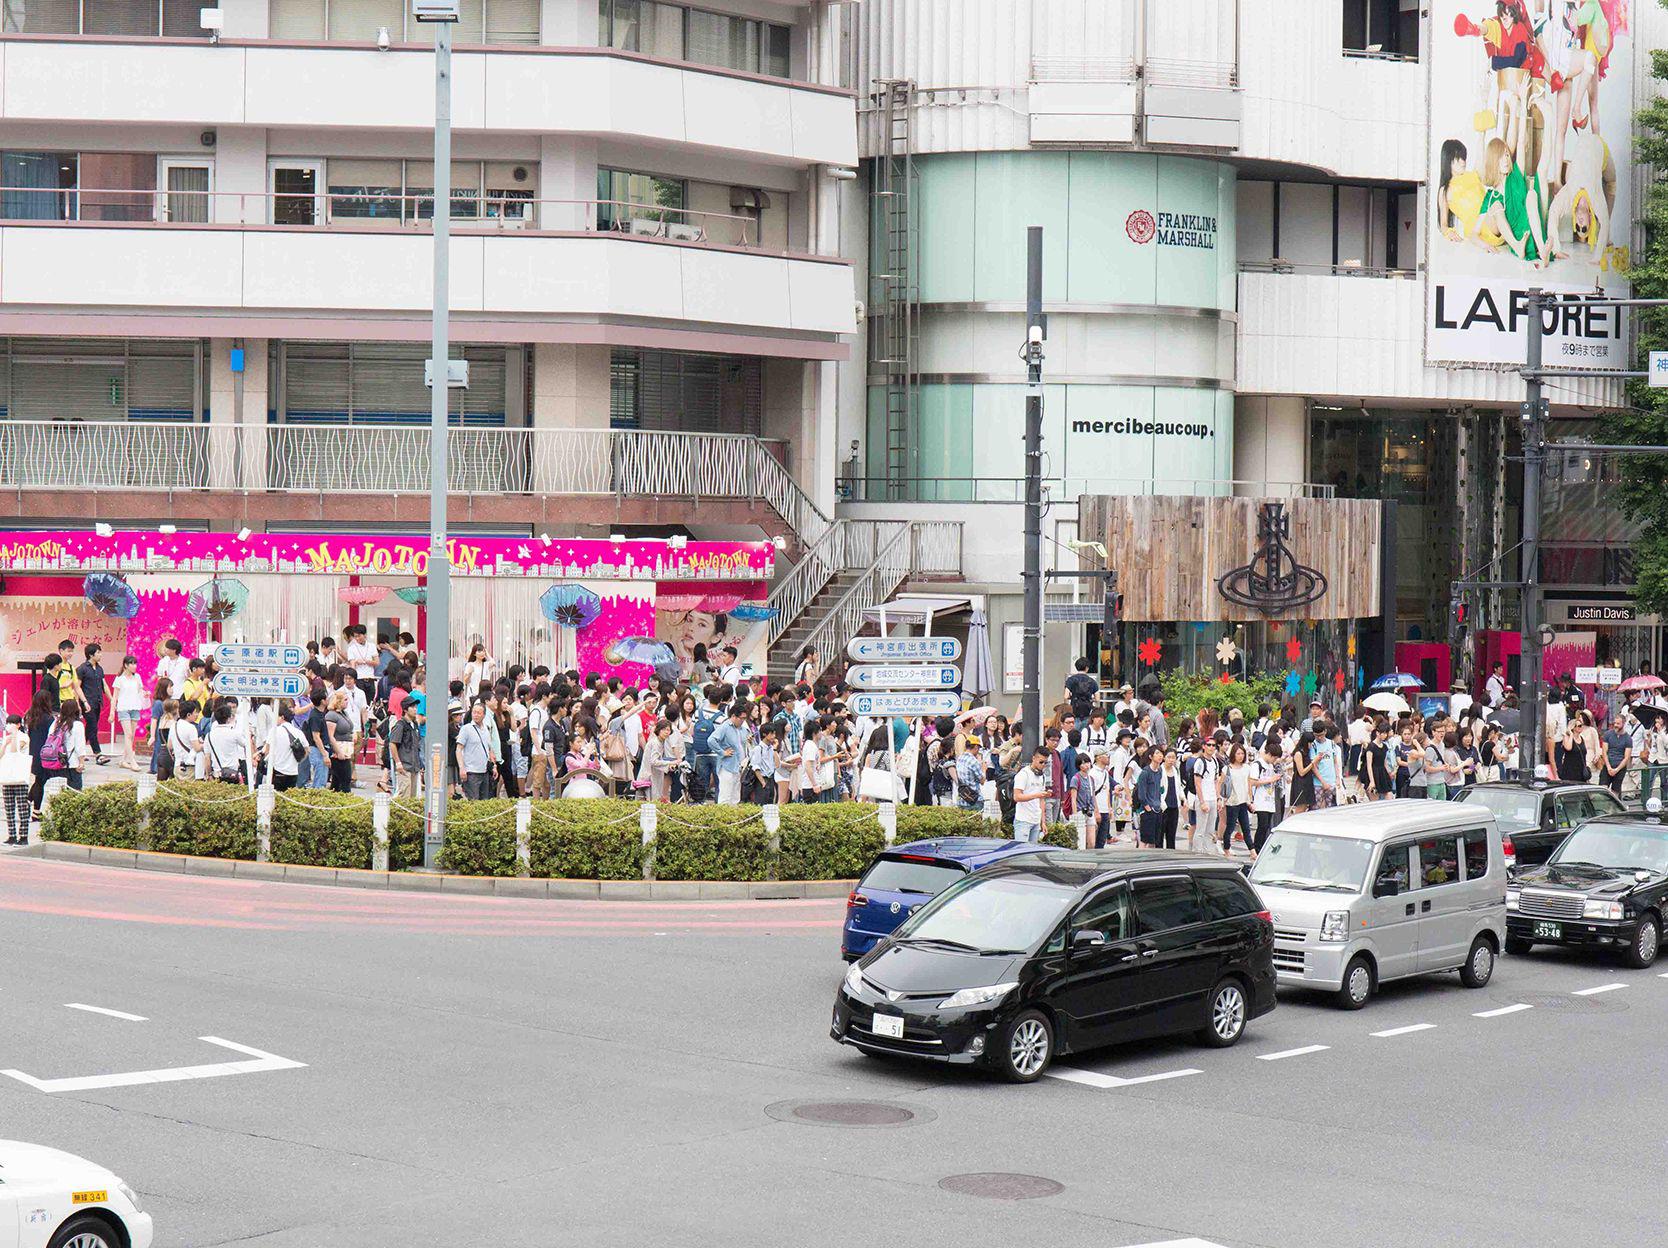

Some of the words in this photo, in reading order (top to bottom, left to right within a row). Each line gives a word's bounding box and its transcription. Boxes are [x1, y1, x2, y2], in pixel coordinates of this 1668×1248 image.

[1157, 229, 1214, 249] MARSHALL
[1562, 342, 1609, 358] 夜9時まで営業
[1072, 417, 1214, 439] mercibeaucoup.
[0, 540, 61, 561] AJOTOWN
[688, 549, 751, 571] MAJOTOWN
[1574, 607, 1601, 619] Justin
[1603, 607, 1630, 619] Davis
[241, 648, 278, 658] 原宿駅
[876, 642, 938, 651] 神宮前出張所
[237, 676, 280, 686] 明治神宮
